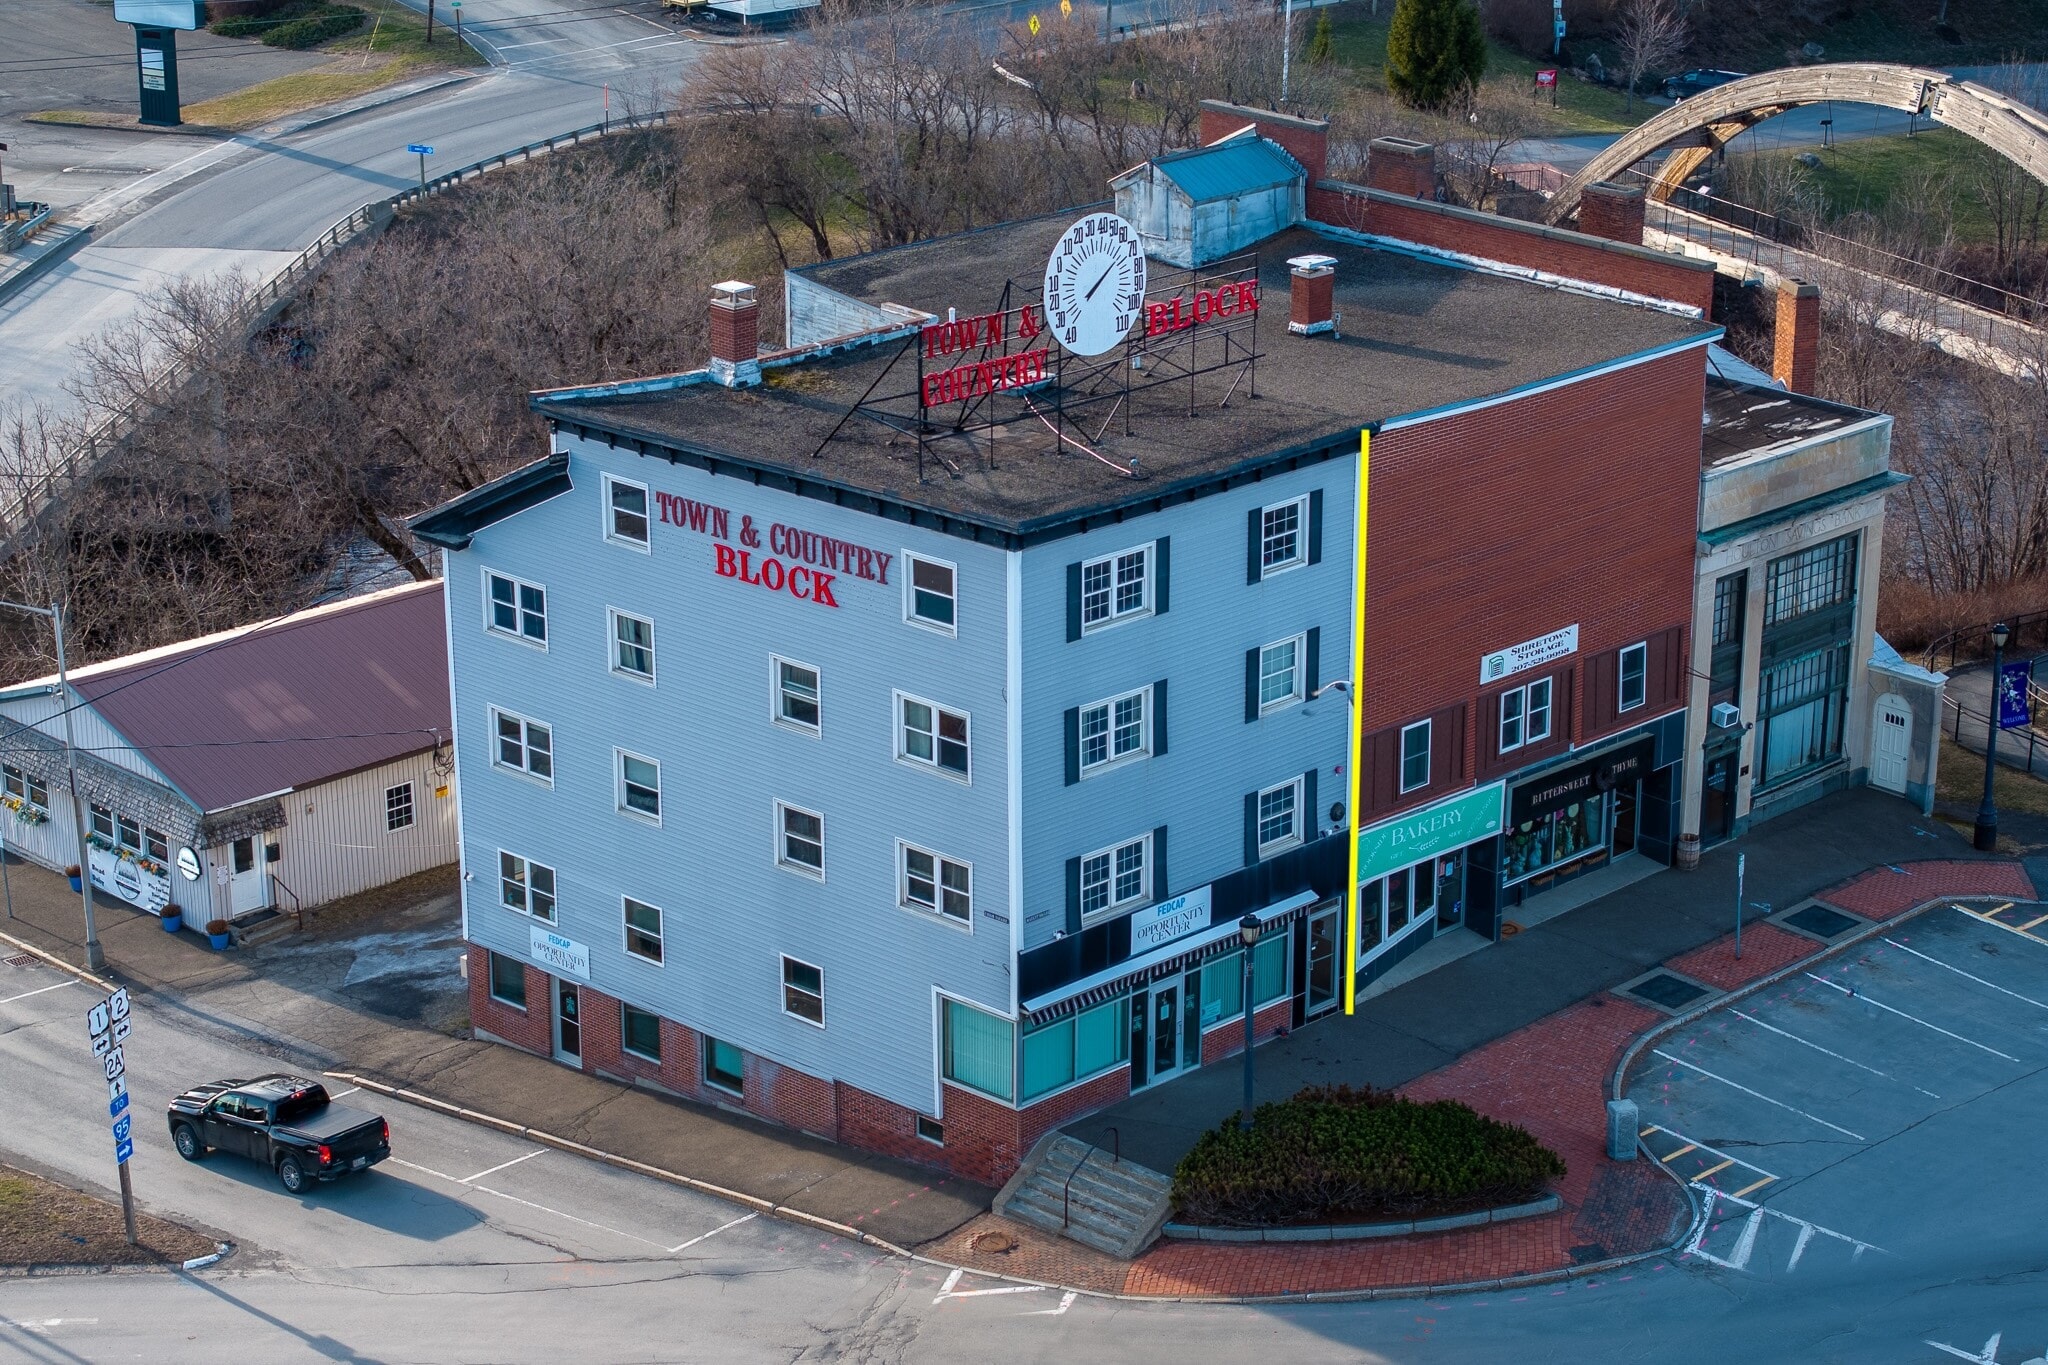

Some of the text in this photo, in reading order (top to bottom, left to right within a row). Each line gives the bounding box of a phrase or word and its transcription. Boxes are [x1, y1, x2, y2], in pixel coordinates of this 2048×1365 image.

[1073, 226, 1084, 244] 20
[1085, 219, 1095, 237] 30
[1097, 216, 1108, 235] 40
[1109, 219, 1119, 237] 50
[1119, 226, 1128, 243] 60
[1063, 238, 1073, 256] 10
[1127, 239, 1138, 257] 70
[1056, 256, 1063, 273] 0
[1133, 256, 1143, 274] 80
[1048, 275, 1059, 293] 10
[1134, 274, 1144, 292] 90
[1049, 293, 1060, 311] 20
[1127, 292, 1140, 312] 100
[1145, 279, 1260, 338] BLOCK
[1055, 311, 1066, 329] 30
[1115, 314, 1129, 333] 110
[921, 304, 1040, 359] TOWN &
[1065, 326, 1077, 344] 40
[922, 348, 1049, 408] COUNTRY
[656, 491, 893, 585] TOWN & COUNTRY
[1726, 506, 1863, 566] HOULTON SAVINGS BANK
[713, 543, 839, 608] BLOCK
[1511, 629, 1572, 656] SHIRETOWN
[1517, 640, 1565, 661] STORAGE
[1532, 757, 1638, 805] BITTERSWEET THYME
[1391, 805, 1467, 846] BAKERY
[1157, 897, 1186, 916] FEDCAP
[1137, 904, 1205, 940] OPPORTUNITY
[548, 934, 571, 948] FEDCAP
[1151, 921, 1190, 943] CENTER
[533, 941, 586, 967] OPPORTUNITY
[544, 952, 576, 970] CENTER
[116, 997, 124, 1012] 2
[96, 1012, 102, 1024] 1
[107, 1054, 122, 1075] 2A
[115, 1100, 124, 1111] TO
[116, 1119, 128, 1138] 95
